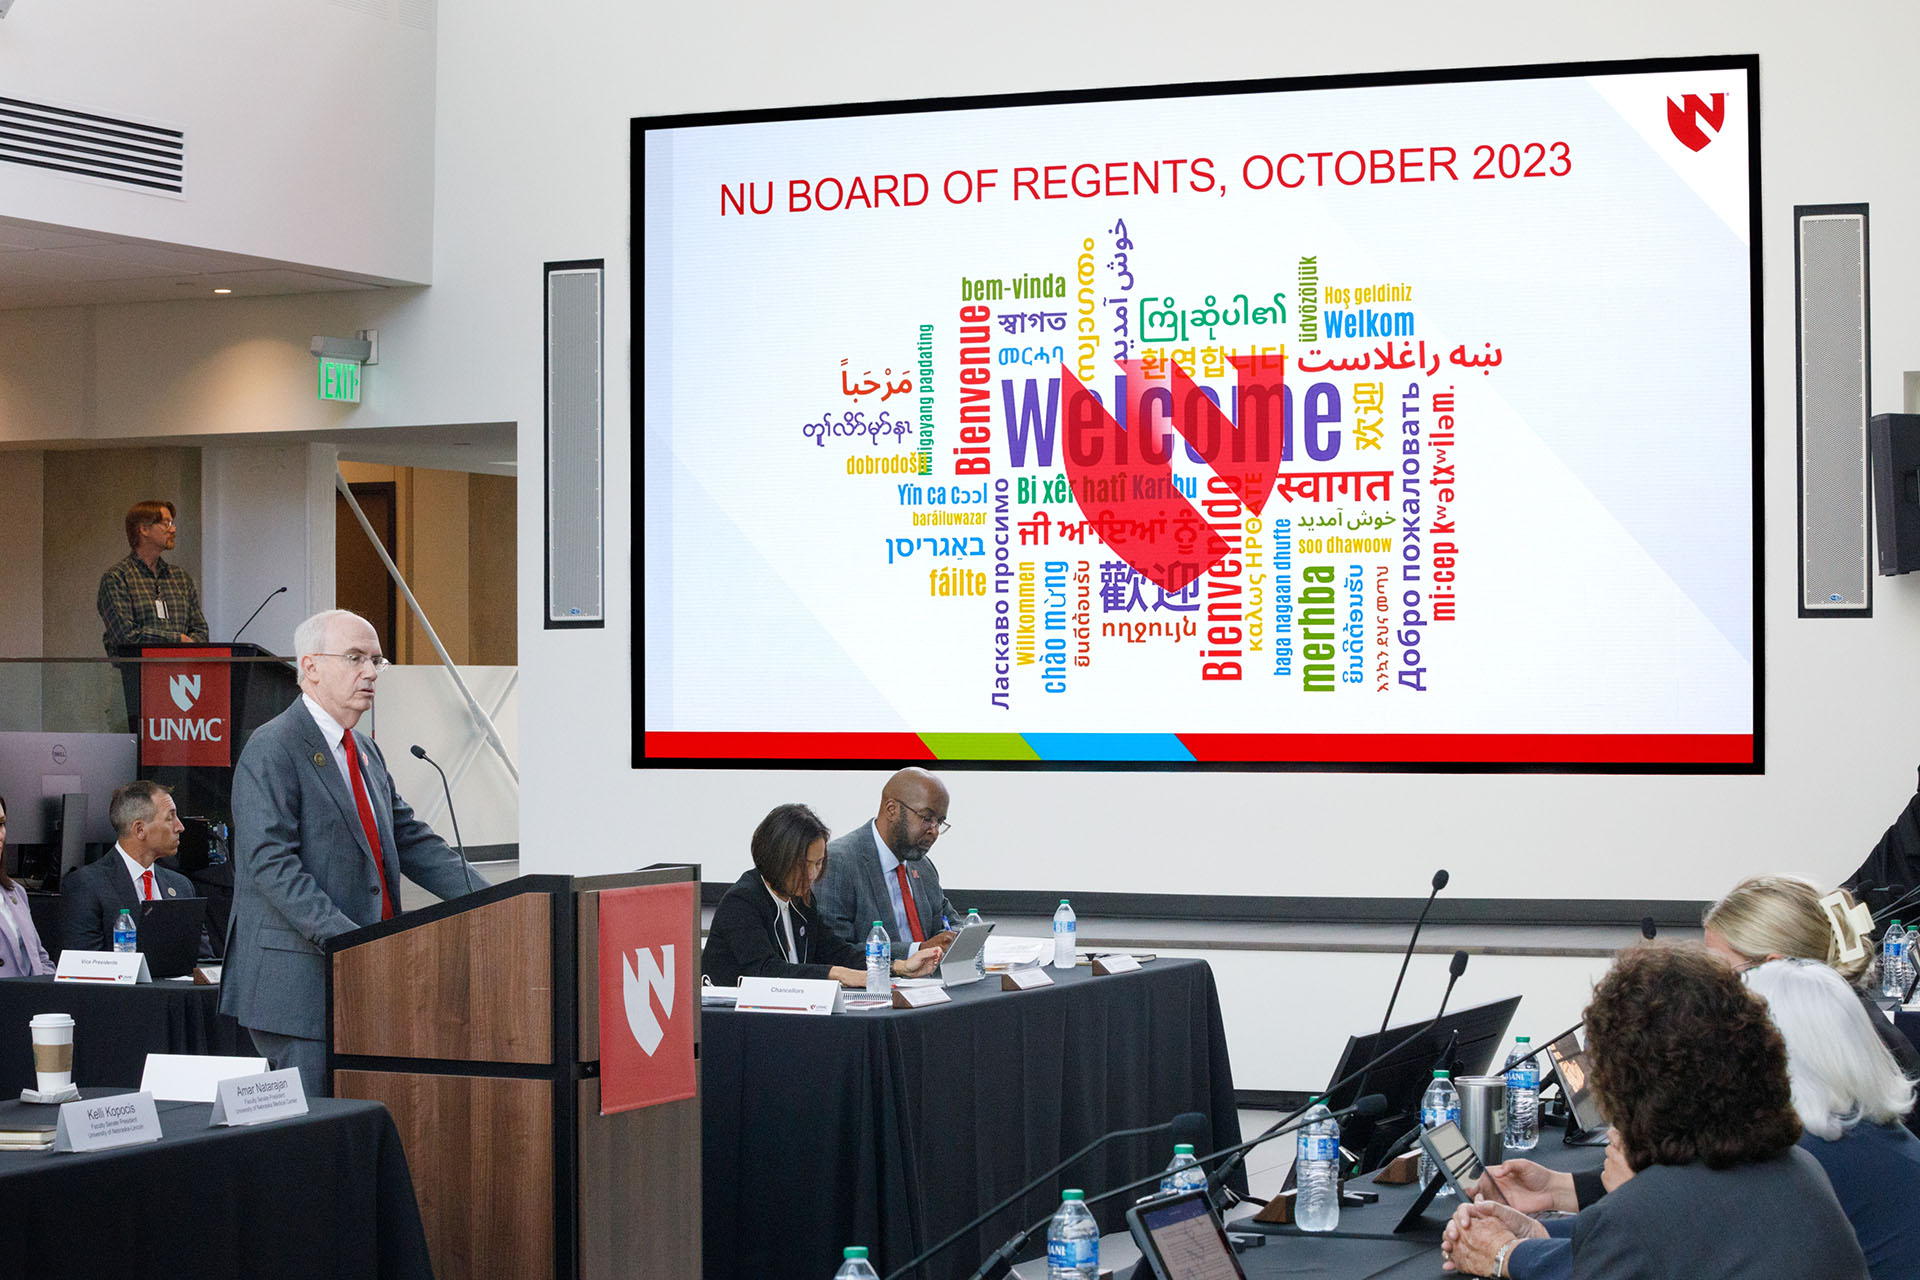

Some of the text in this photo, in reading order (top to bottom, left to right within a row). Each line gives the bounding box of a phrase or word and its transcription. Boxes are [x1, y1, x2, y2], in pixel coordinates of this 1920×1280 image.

[721, 141, 1572, 216] NU BOARD OF REGENTS, OCTOBER 2023
[961, 273, 1066, 301] bem-vinda
[1298, 255, 1319, 342] üdvözöljük
[1324, 282, 1412, 309] Hoş geldiniz
[998, 311, 1067, 335] স্বাগত
[1324, 309, 1415, 338] Welkom
[1140, 344, 1289, 380] 환영합니다
[325, 362, 357, 400] EXIT
[953, 305, 991, 475] Bienvenue
[917, 324, 934, 476] Maligayang pagdating
[1353, 382, 1384, 451] 欢迎
[1001, 375, 1342, 468] Welcome
[846, 451, 928, 475] dobrodošli
[927, 486, 946, 505] ca
[1017, 472, 1127, 504] Bi xêr hatî
[1132, 473, 1197, 500] Karibu
[1277, 471, 1394, 503] स्वागत
[912, 511, 988, 527] baráiluwazar
[1017, 511, 1052, 546] ਜੀ
[1347, 510, 1396, 531] خوش
[1299, 536, 1392, 554] soo dhawoow
[1397, 382, 1427, 692] Добро пожаловать
[929, 566, 987, 597] fáilte
[991, 478, 1014, 710] Ласкаво просимо
[1099, 560, 1200, 613] 歡迎
[1200, 475, 1242, 680] Bienvenido
[1016, 561, 1036, 666] Willkommen
[1072, 560, 1091, 668] ยินดีต้อนรับ
[1245, 574, 1267, 651] καλως
[1273, 518, 1293, 676] baga nagaan dhufte
[1039, 561, 1069, 693] chào mừng
[1298, 565, 1335, 692] merhba
[149, 718, 222, 742] UNMC
[771, 986, 804, 994] Chancellors
[237, 1080, 289, 1097] Amar Natarajan
[87, 1106, 105, 1120] Kelli
